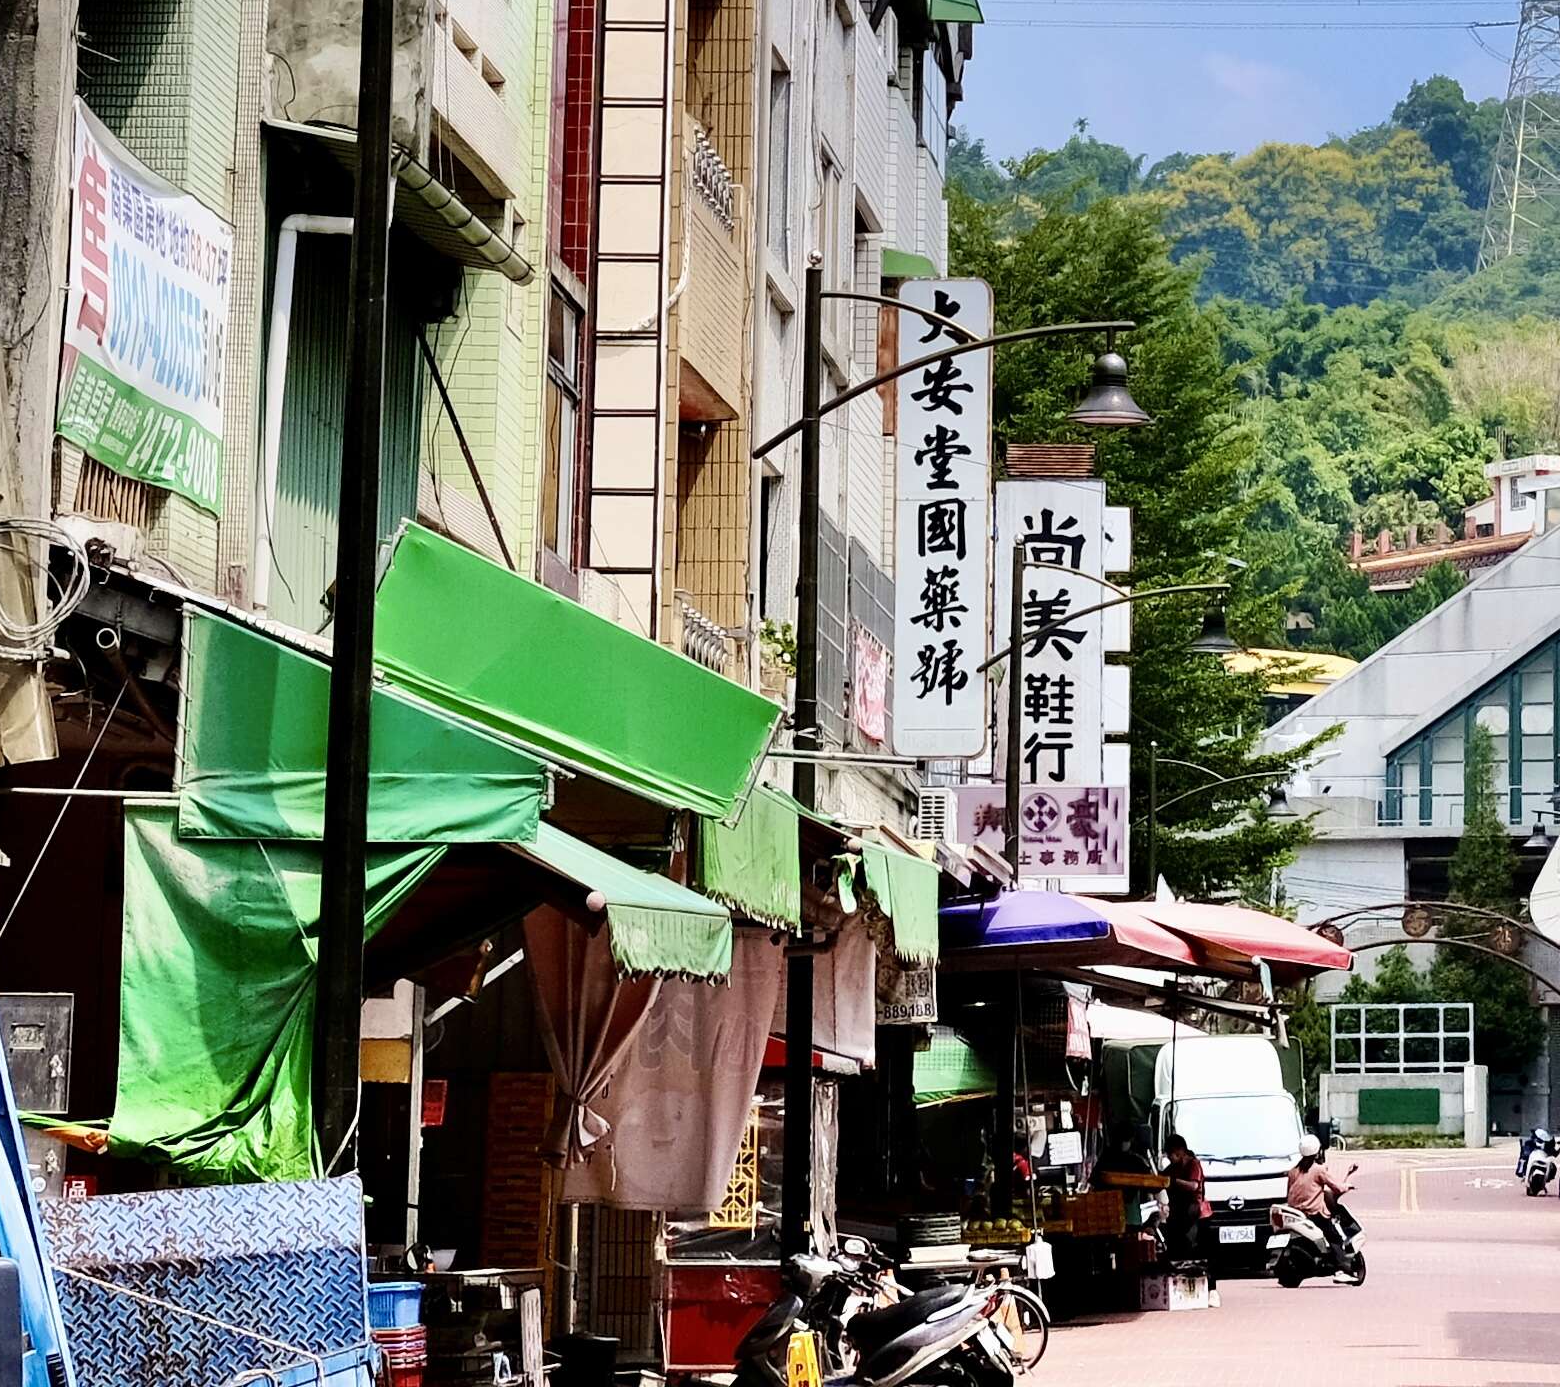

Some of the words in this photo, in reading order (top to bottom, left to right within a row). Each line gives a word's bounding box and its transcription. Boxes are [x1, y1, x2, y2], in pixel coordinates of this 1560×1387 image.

[909, 290, 974, 706] 大安堂國藥號
[1021, 507, 1089, 782] 尚美鞋行
